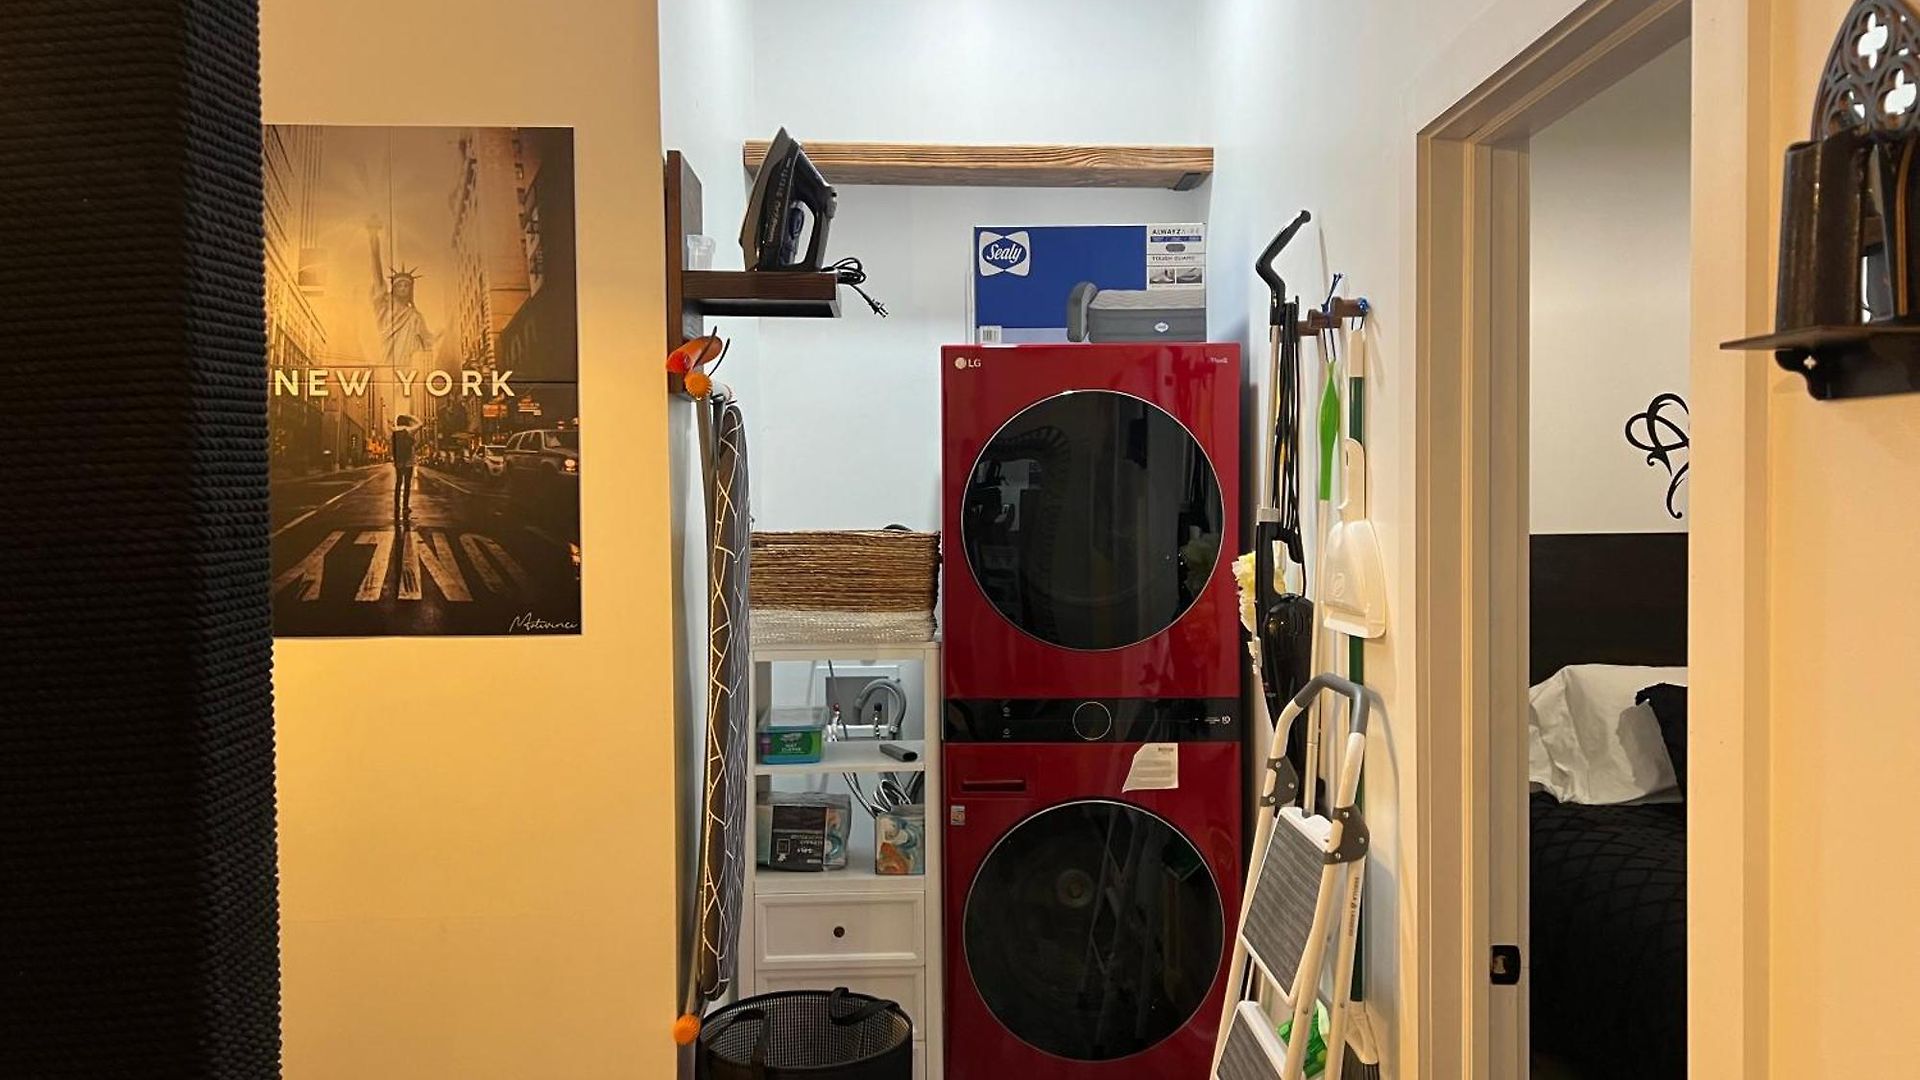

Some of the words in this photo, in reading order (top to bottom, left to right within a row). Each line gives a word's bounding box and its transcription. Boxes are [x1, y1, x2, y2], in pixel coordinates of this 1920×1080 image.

[986, 242, 1022, 263] Sealy
[967, 358, 981, 368] LG
[274, 369, 371, 397] NEW
[396, 369, 515, 397] YORK
